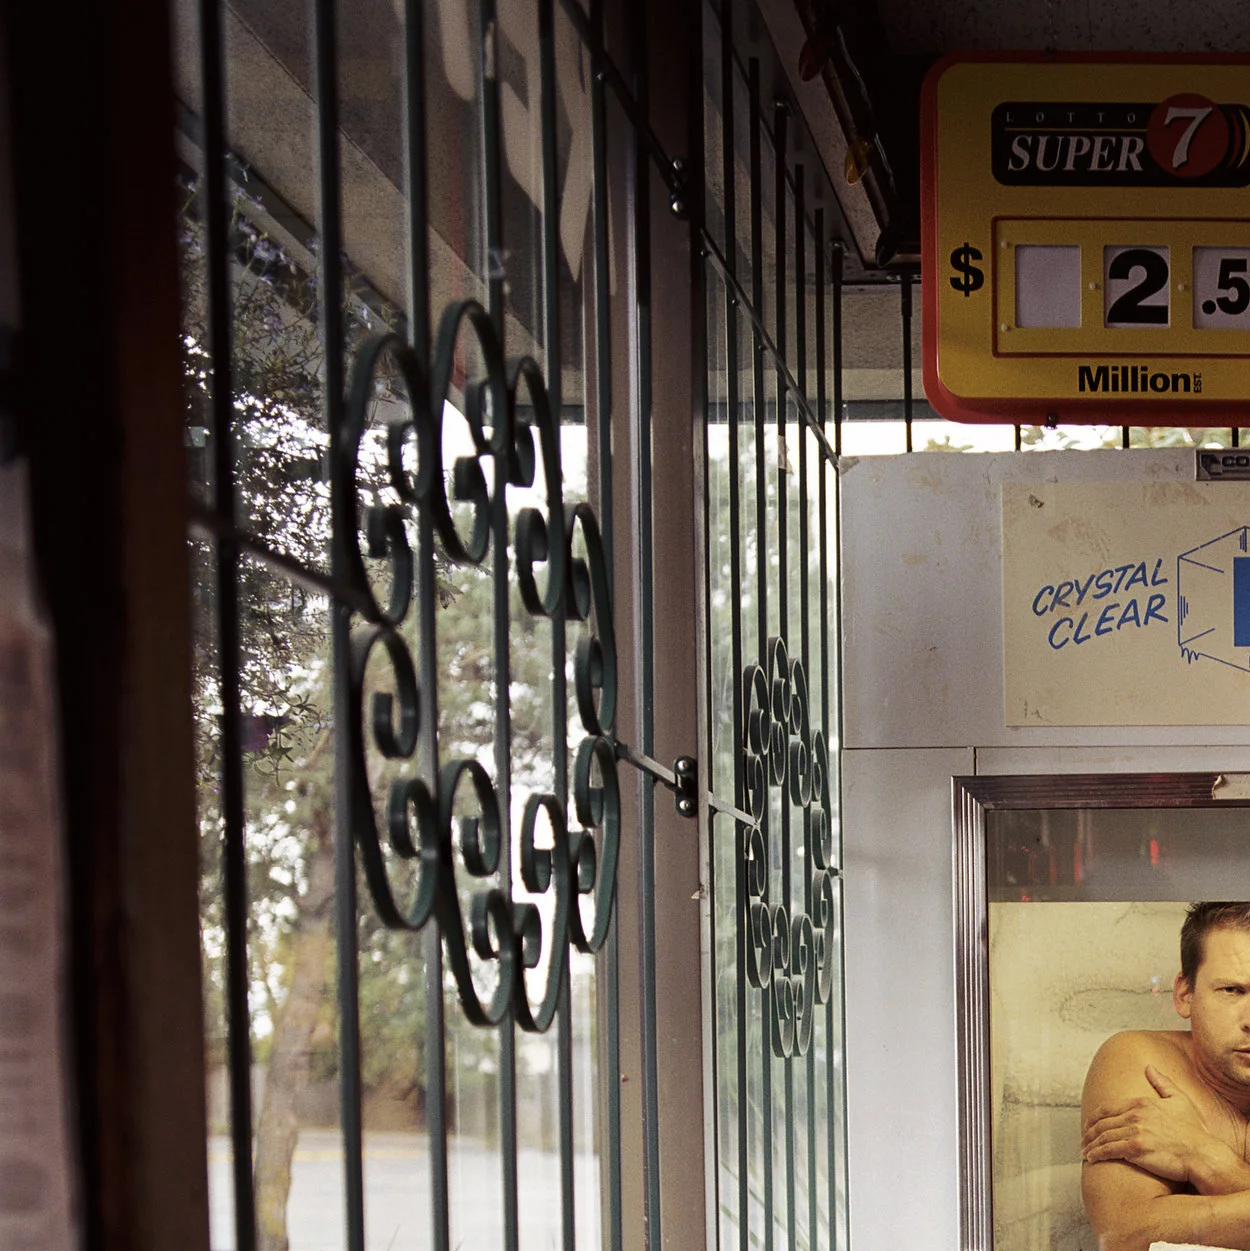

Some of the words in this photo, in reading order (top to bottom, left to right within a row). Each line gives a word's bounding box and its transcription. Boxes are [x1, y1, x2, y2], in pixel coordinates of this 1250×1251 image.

[1005, 111, 1137, 124] LOTTO
[1007, 134, 1144, 172] SUPER
[1163, 106, 1213, 169] 7
[950, 242, 984, 296] $
[1078, 366, 1191, 392] Million
[1032, 558, 1168, 617] CRYSTAL
[1048, 592, 1168, 650] CLEAR
